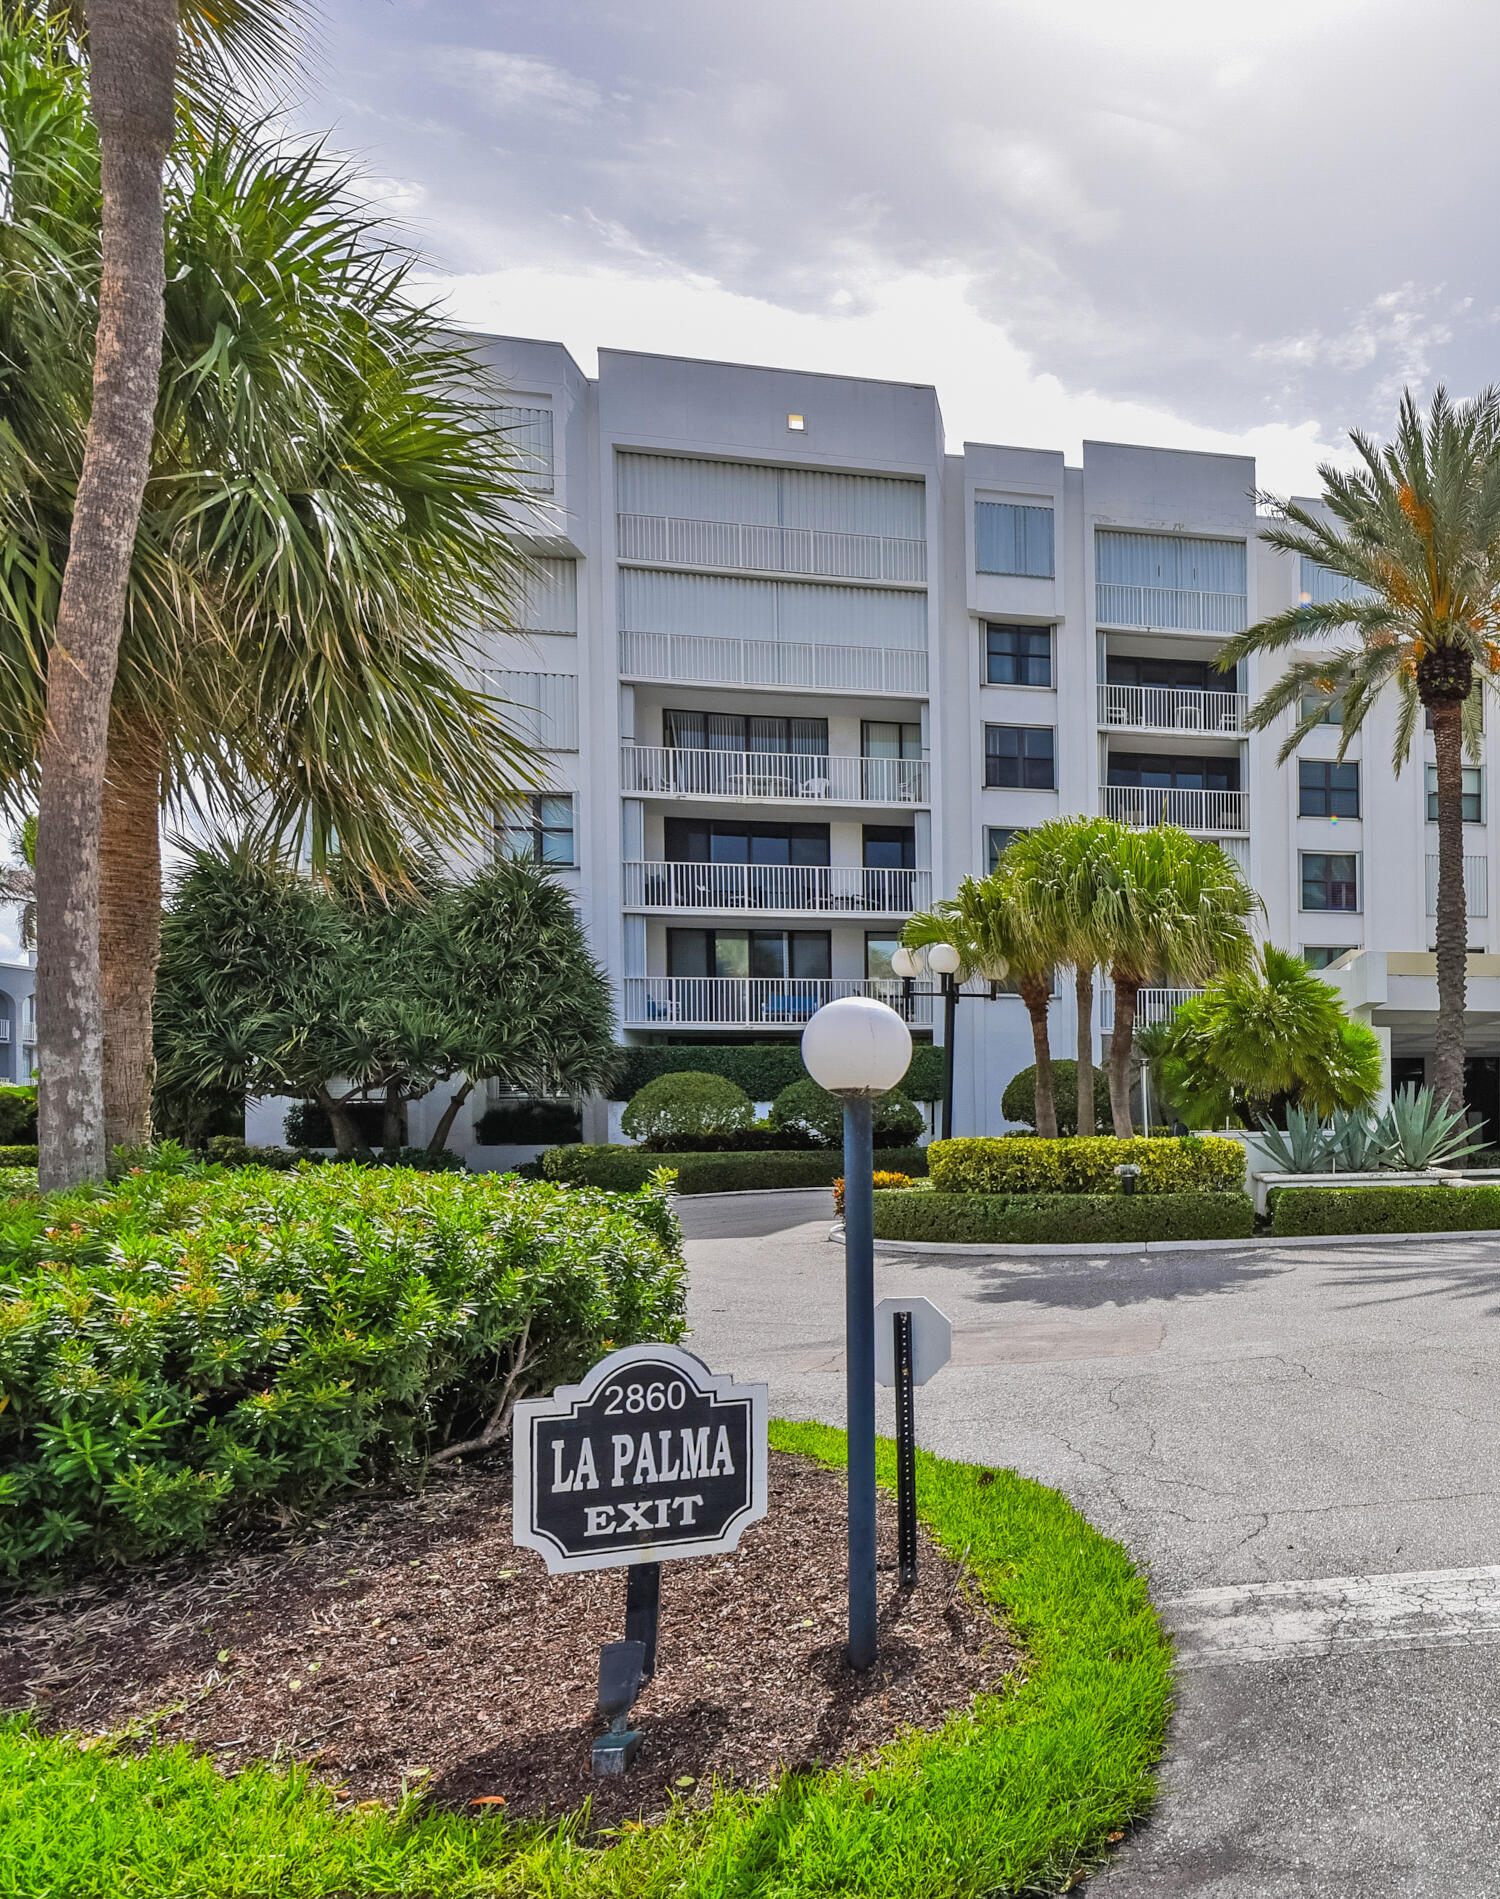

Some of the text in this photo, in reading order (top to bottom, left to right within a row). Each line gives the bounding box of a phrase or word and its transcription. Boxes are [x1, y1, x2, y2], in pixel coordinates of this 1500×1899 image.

[604, 1381, 686, 1415] 2860
[551, 1425, 736, 1493] LA PALMA
[583, 1494, 704, 1537] EXIT
